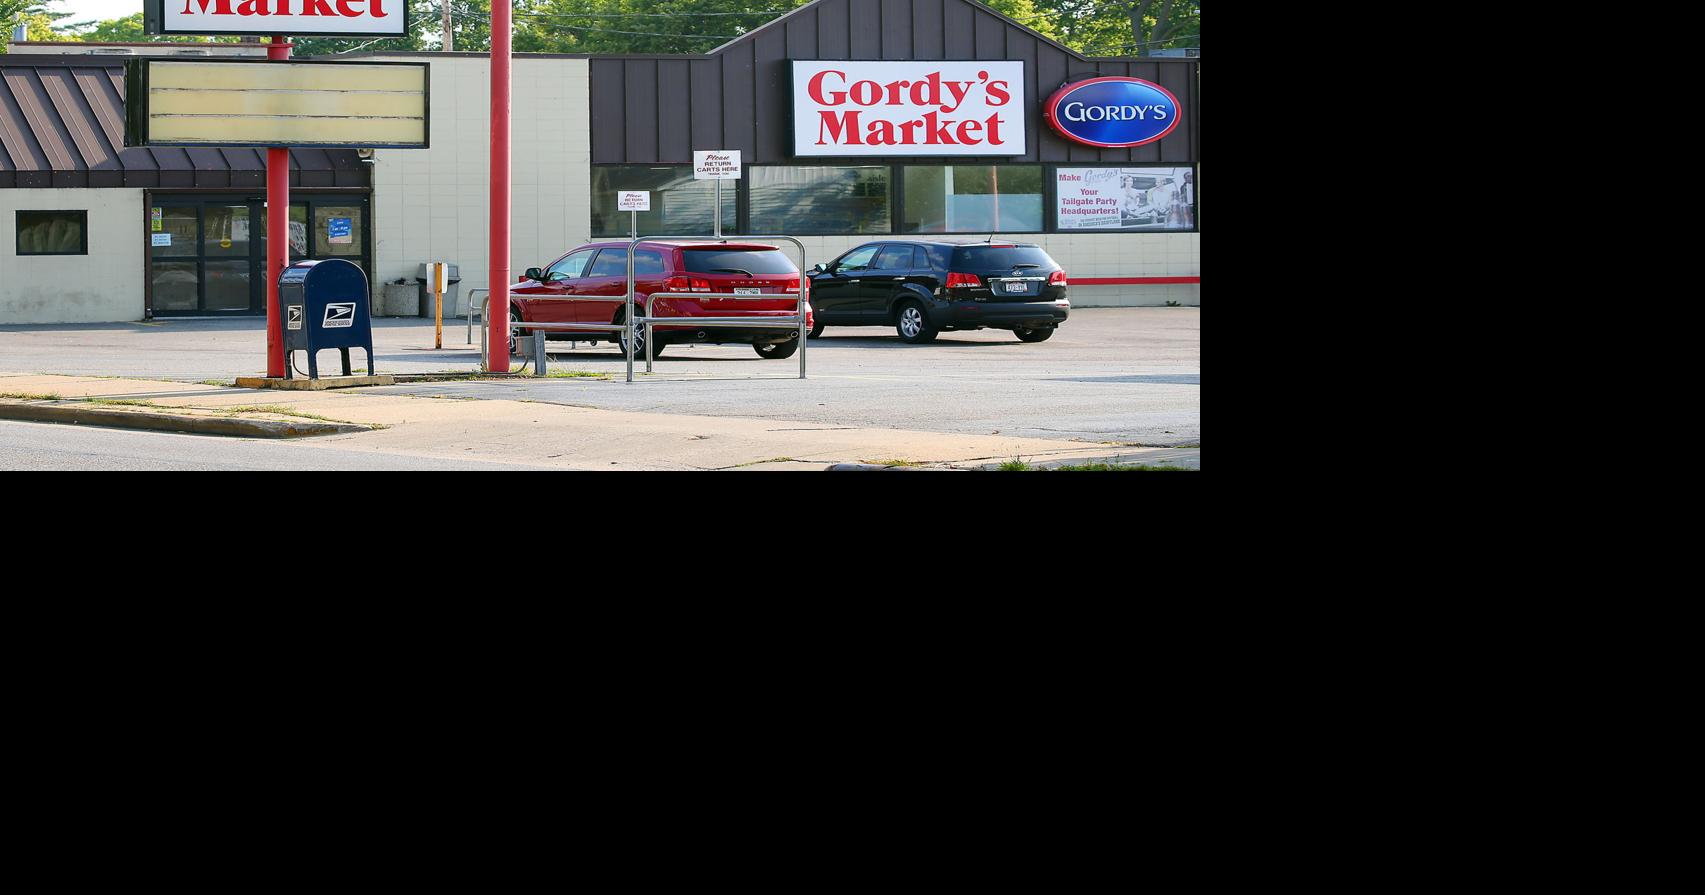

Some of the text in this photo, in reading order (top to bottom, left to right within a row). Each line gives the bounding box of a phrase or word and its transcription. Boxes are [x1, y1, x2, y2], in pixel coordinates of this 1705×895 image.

[807, 70, 1010, 114] Gordy's
[1064, 101, 1167, 122] GORDY'S
[814, 110, 1005, 146] Market
[1058, 174, 1082, 182] Make
[1080, 188, 1099, 196] Your
[1062, 197, 1118, 207] Tailgate Party
[1060, 207, 1119, 216] Headquarters!
